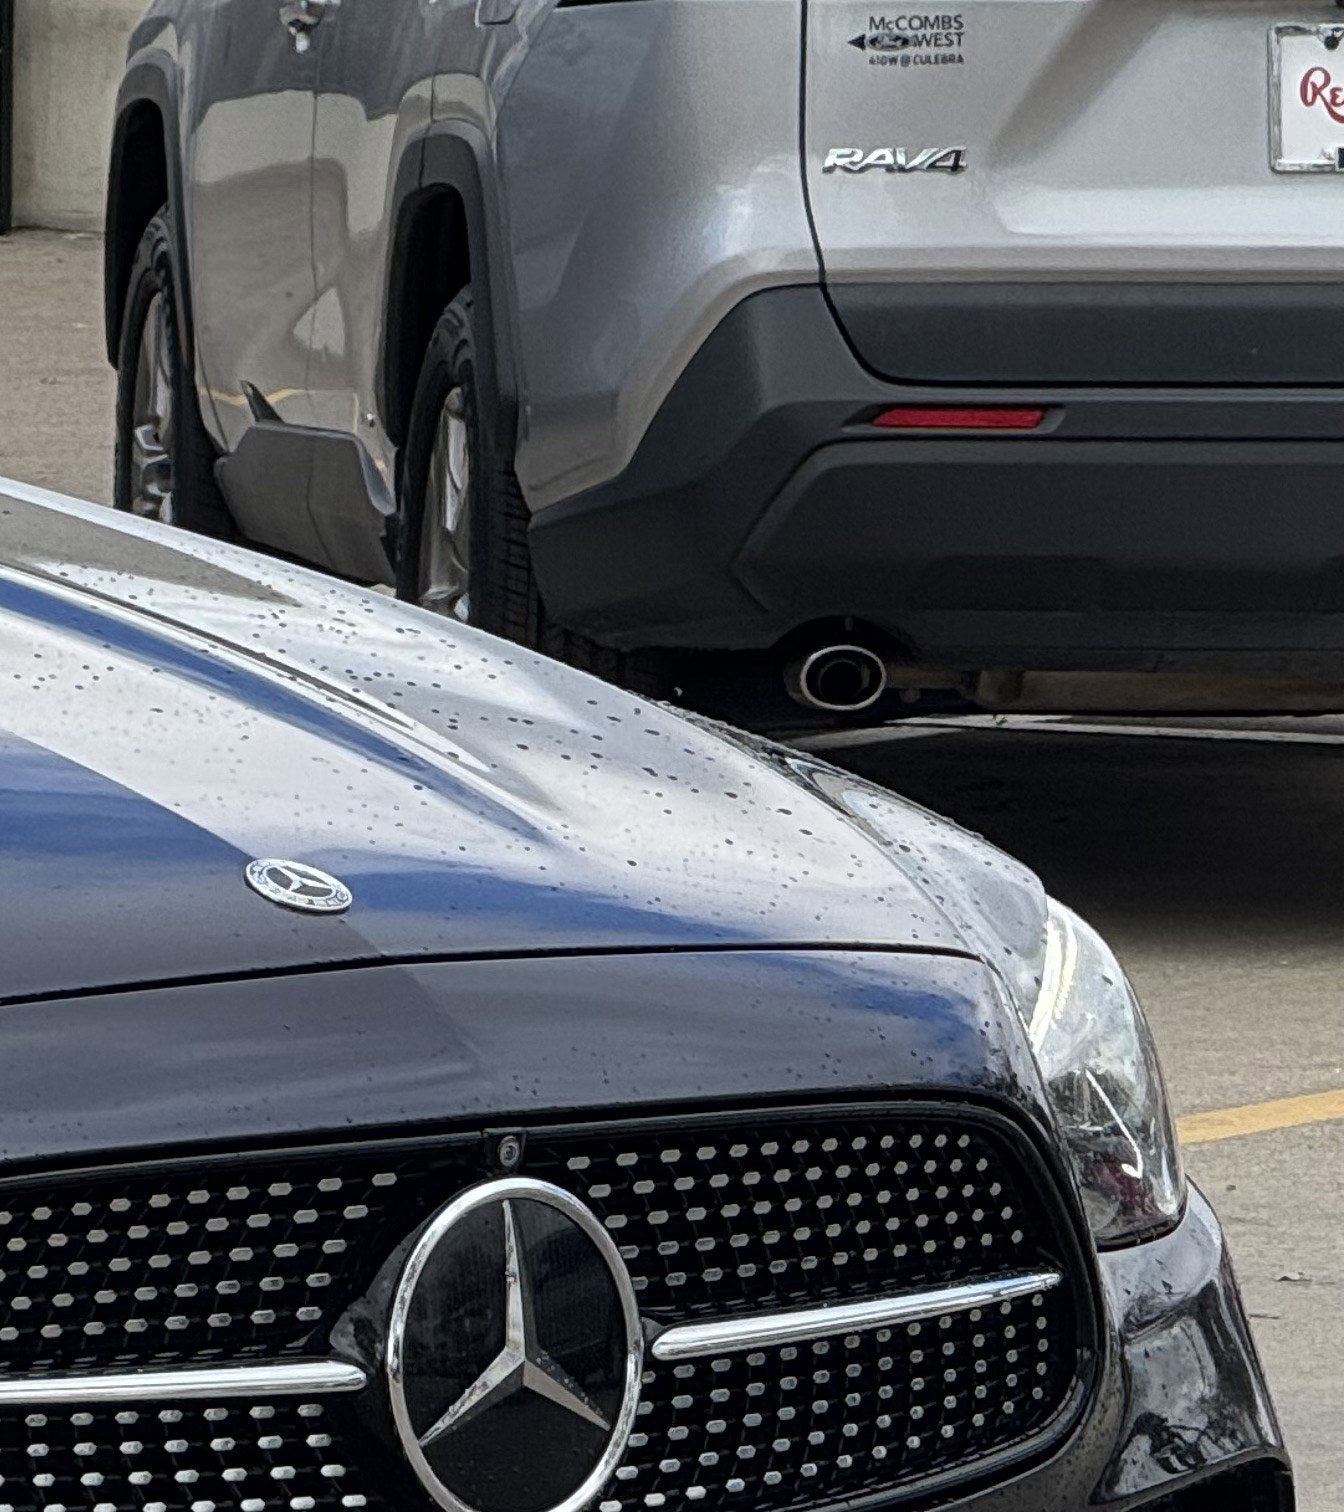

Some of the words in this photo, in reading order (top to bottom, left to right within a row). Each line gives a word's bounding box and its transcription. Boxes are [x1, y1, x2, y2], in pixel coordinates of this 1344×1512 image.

[868, 13, 965, 31] McCOMBS
[913, 31, 965, 48] WEST
[913, 53, 965, 66] CULEBRA
[1299, 66, 1344, 124] Re
[823, 146, 967, 174] RAV4
